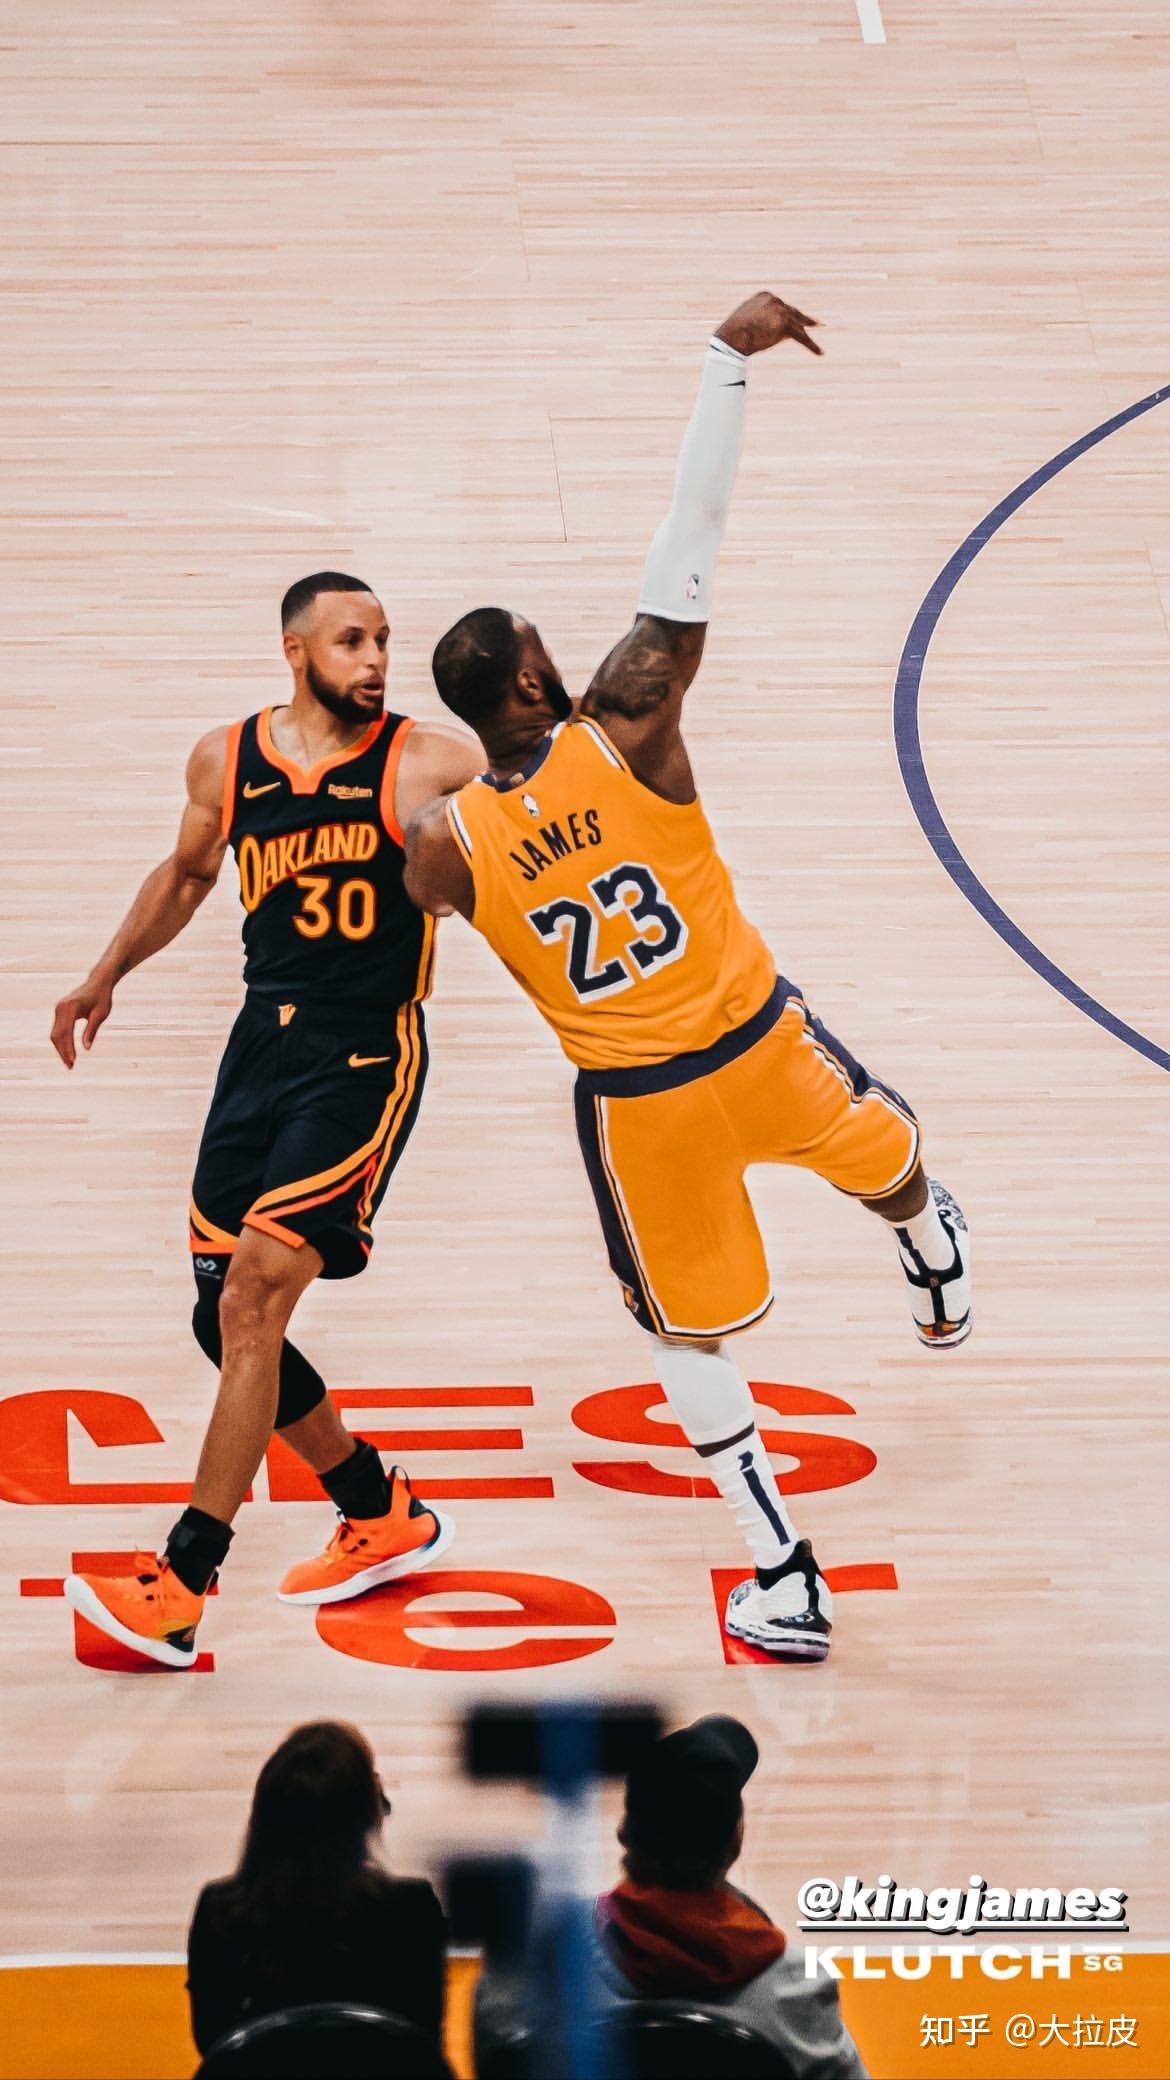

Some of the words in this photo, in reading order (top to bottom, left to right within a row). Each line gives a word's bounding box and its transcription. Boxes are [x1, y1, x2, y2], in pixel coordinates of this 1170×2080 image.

[238, 822, 380, 914] OAKLAND
[509, 809, 602, 882] JAMES
[292, 873, 378, 941] 30
[525, 861, 689, 1005] 23
